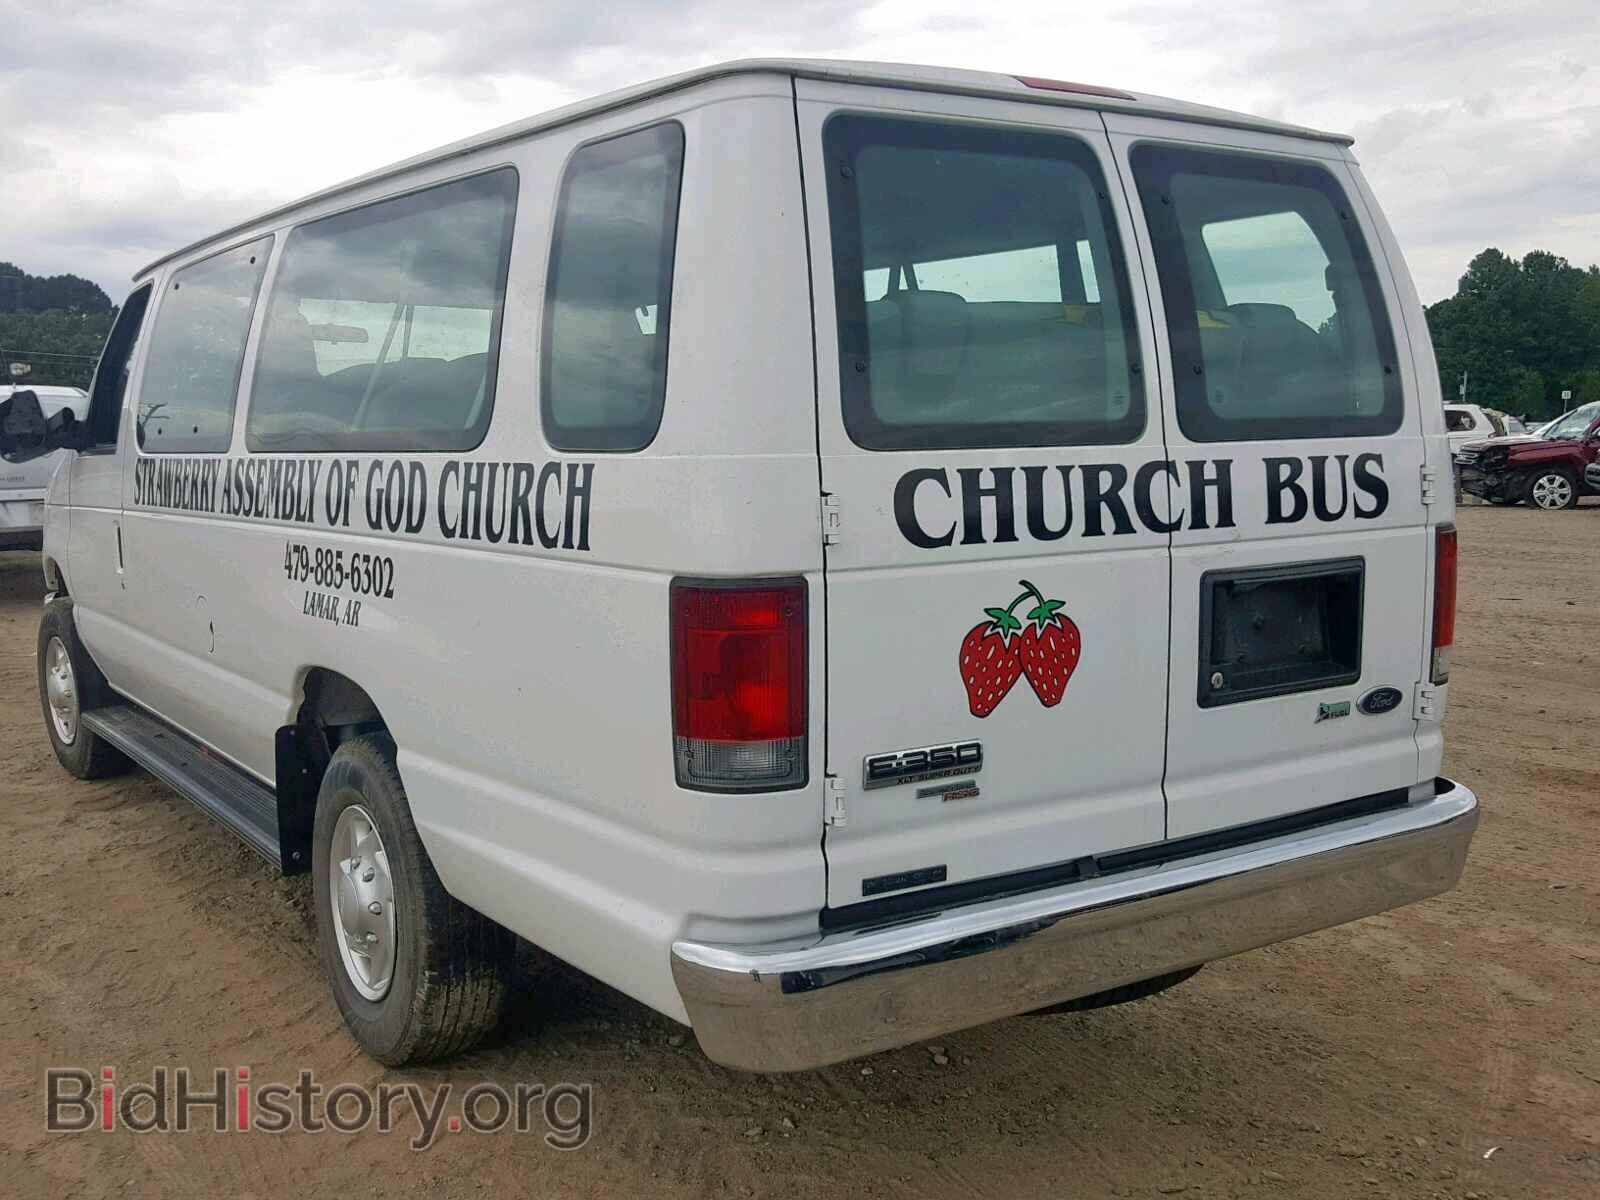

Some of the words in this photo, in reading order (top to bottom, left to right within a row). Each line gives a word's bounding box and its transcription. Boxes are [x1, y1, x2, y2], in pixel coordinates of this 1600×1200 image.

[134, 457, 218, 512] STRAWBERRY
[220, 459, 321, 524] ASSEMBLY
[325, 459, 360, 527] OF
[365, 459, 426, 534] GOD
[438, 460, 595, 551] CHURCH
[893, 459, 1236, 549] CHURCH
[1262, 452, 1390, 525] BUS
[284, 541, 395, 598] 479-885-6302
[303, 590, 341, 626] LAMAR,
[342, 599, 360, 627] AR
